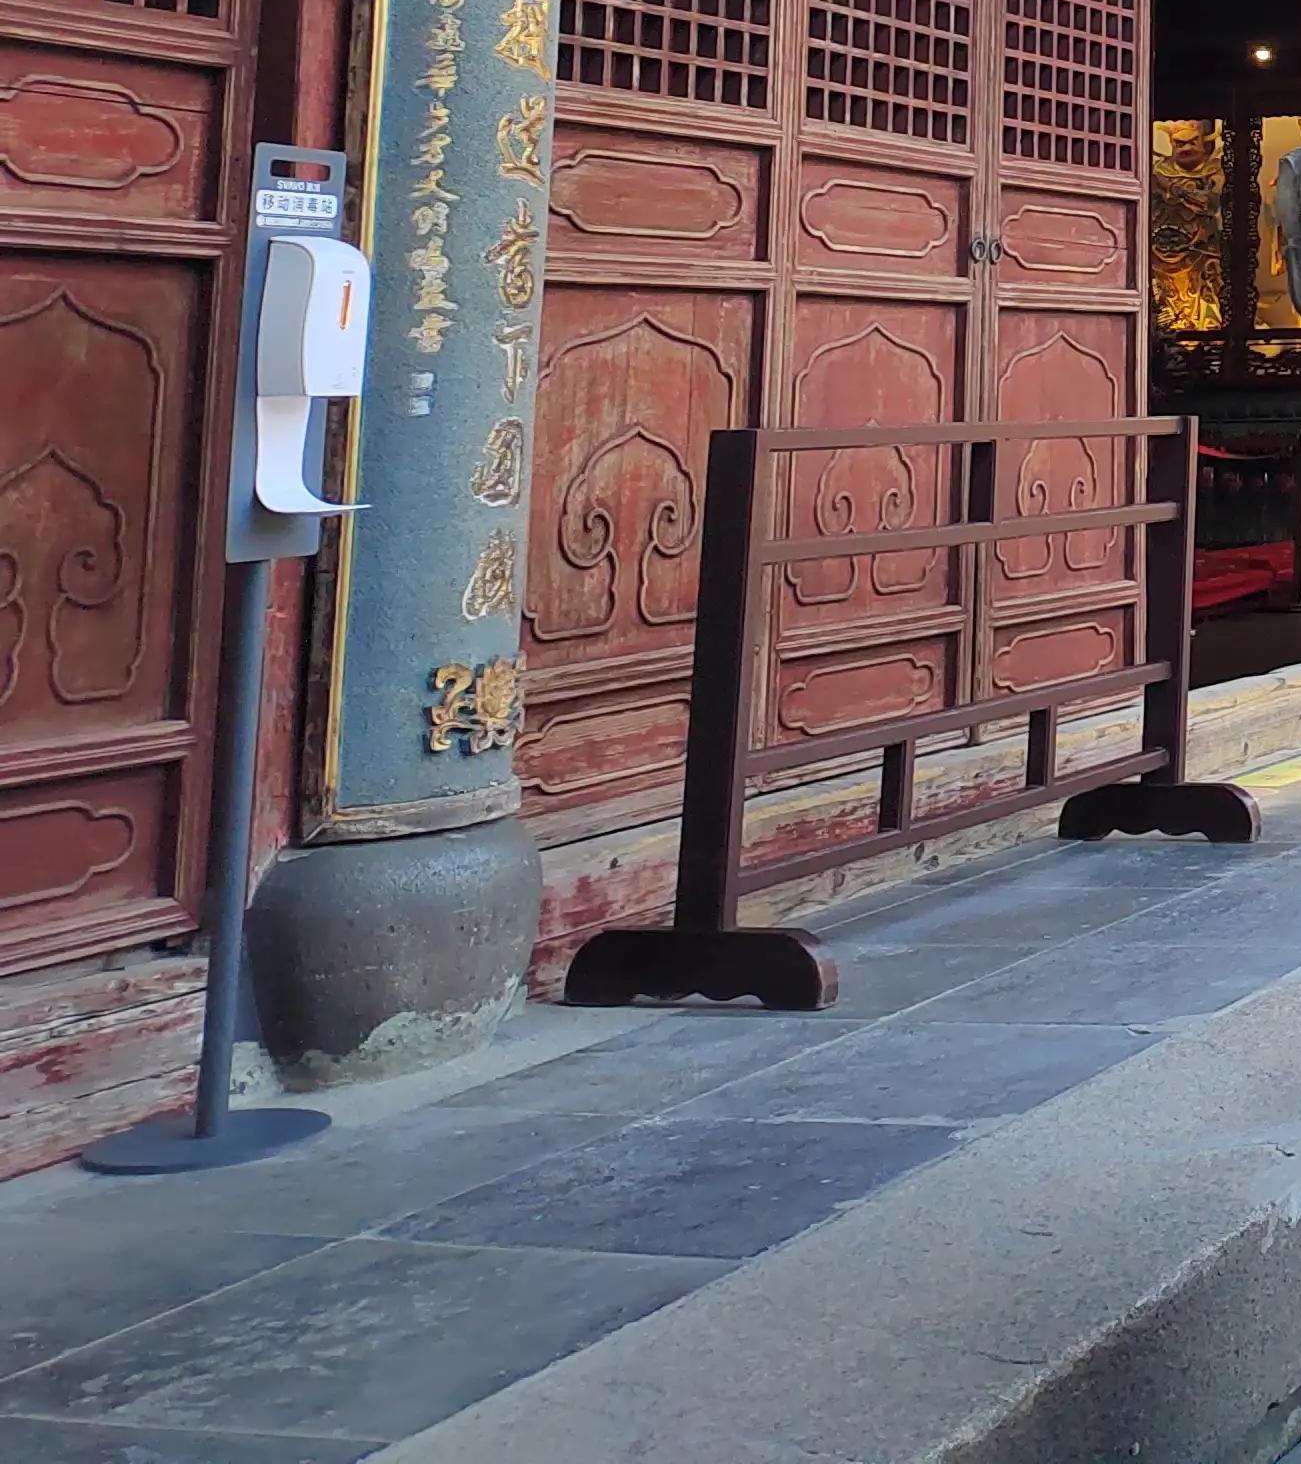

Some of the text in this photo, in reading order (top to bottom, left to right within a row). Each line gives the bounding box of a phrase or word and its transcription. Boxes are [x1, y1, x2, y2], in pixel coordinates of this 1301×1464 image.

[263, 193, 333, 214] 移动消毒站
